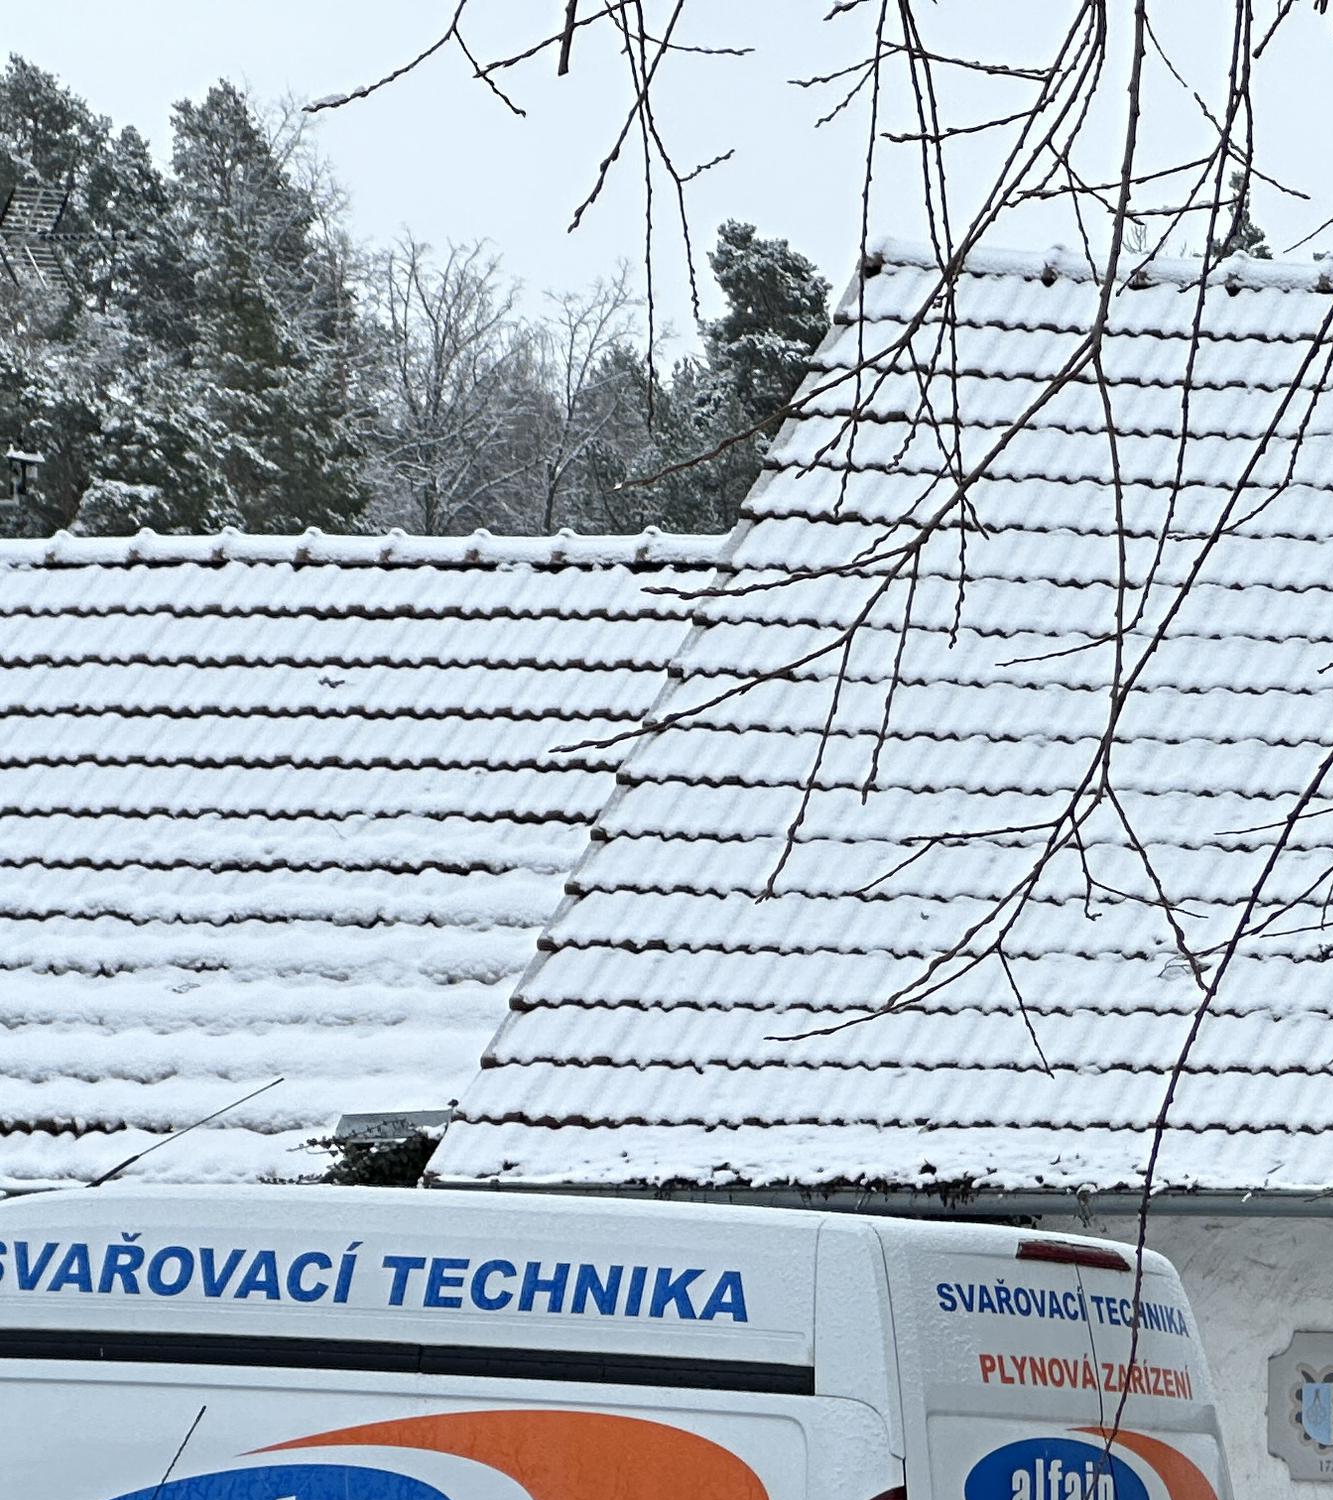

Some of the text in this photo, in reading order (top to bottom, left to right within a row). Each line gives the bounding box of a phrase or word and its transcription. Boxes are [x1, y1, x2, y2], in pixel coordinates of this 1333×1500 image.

[0, 1232, 749, 1323] VAŘOVACÍ TECHNIKA
[936, 1278, 1191, 1338] SVAŘOVACÍ TECHNIKA
[979, 1353, 1194, 1401] PLYNOVÁ ZAŘÍZENÍ
